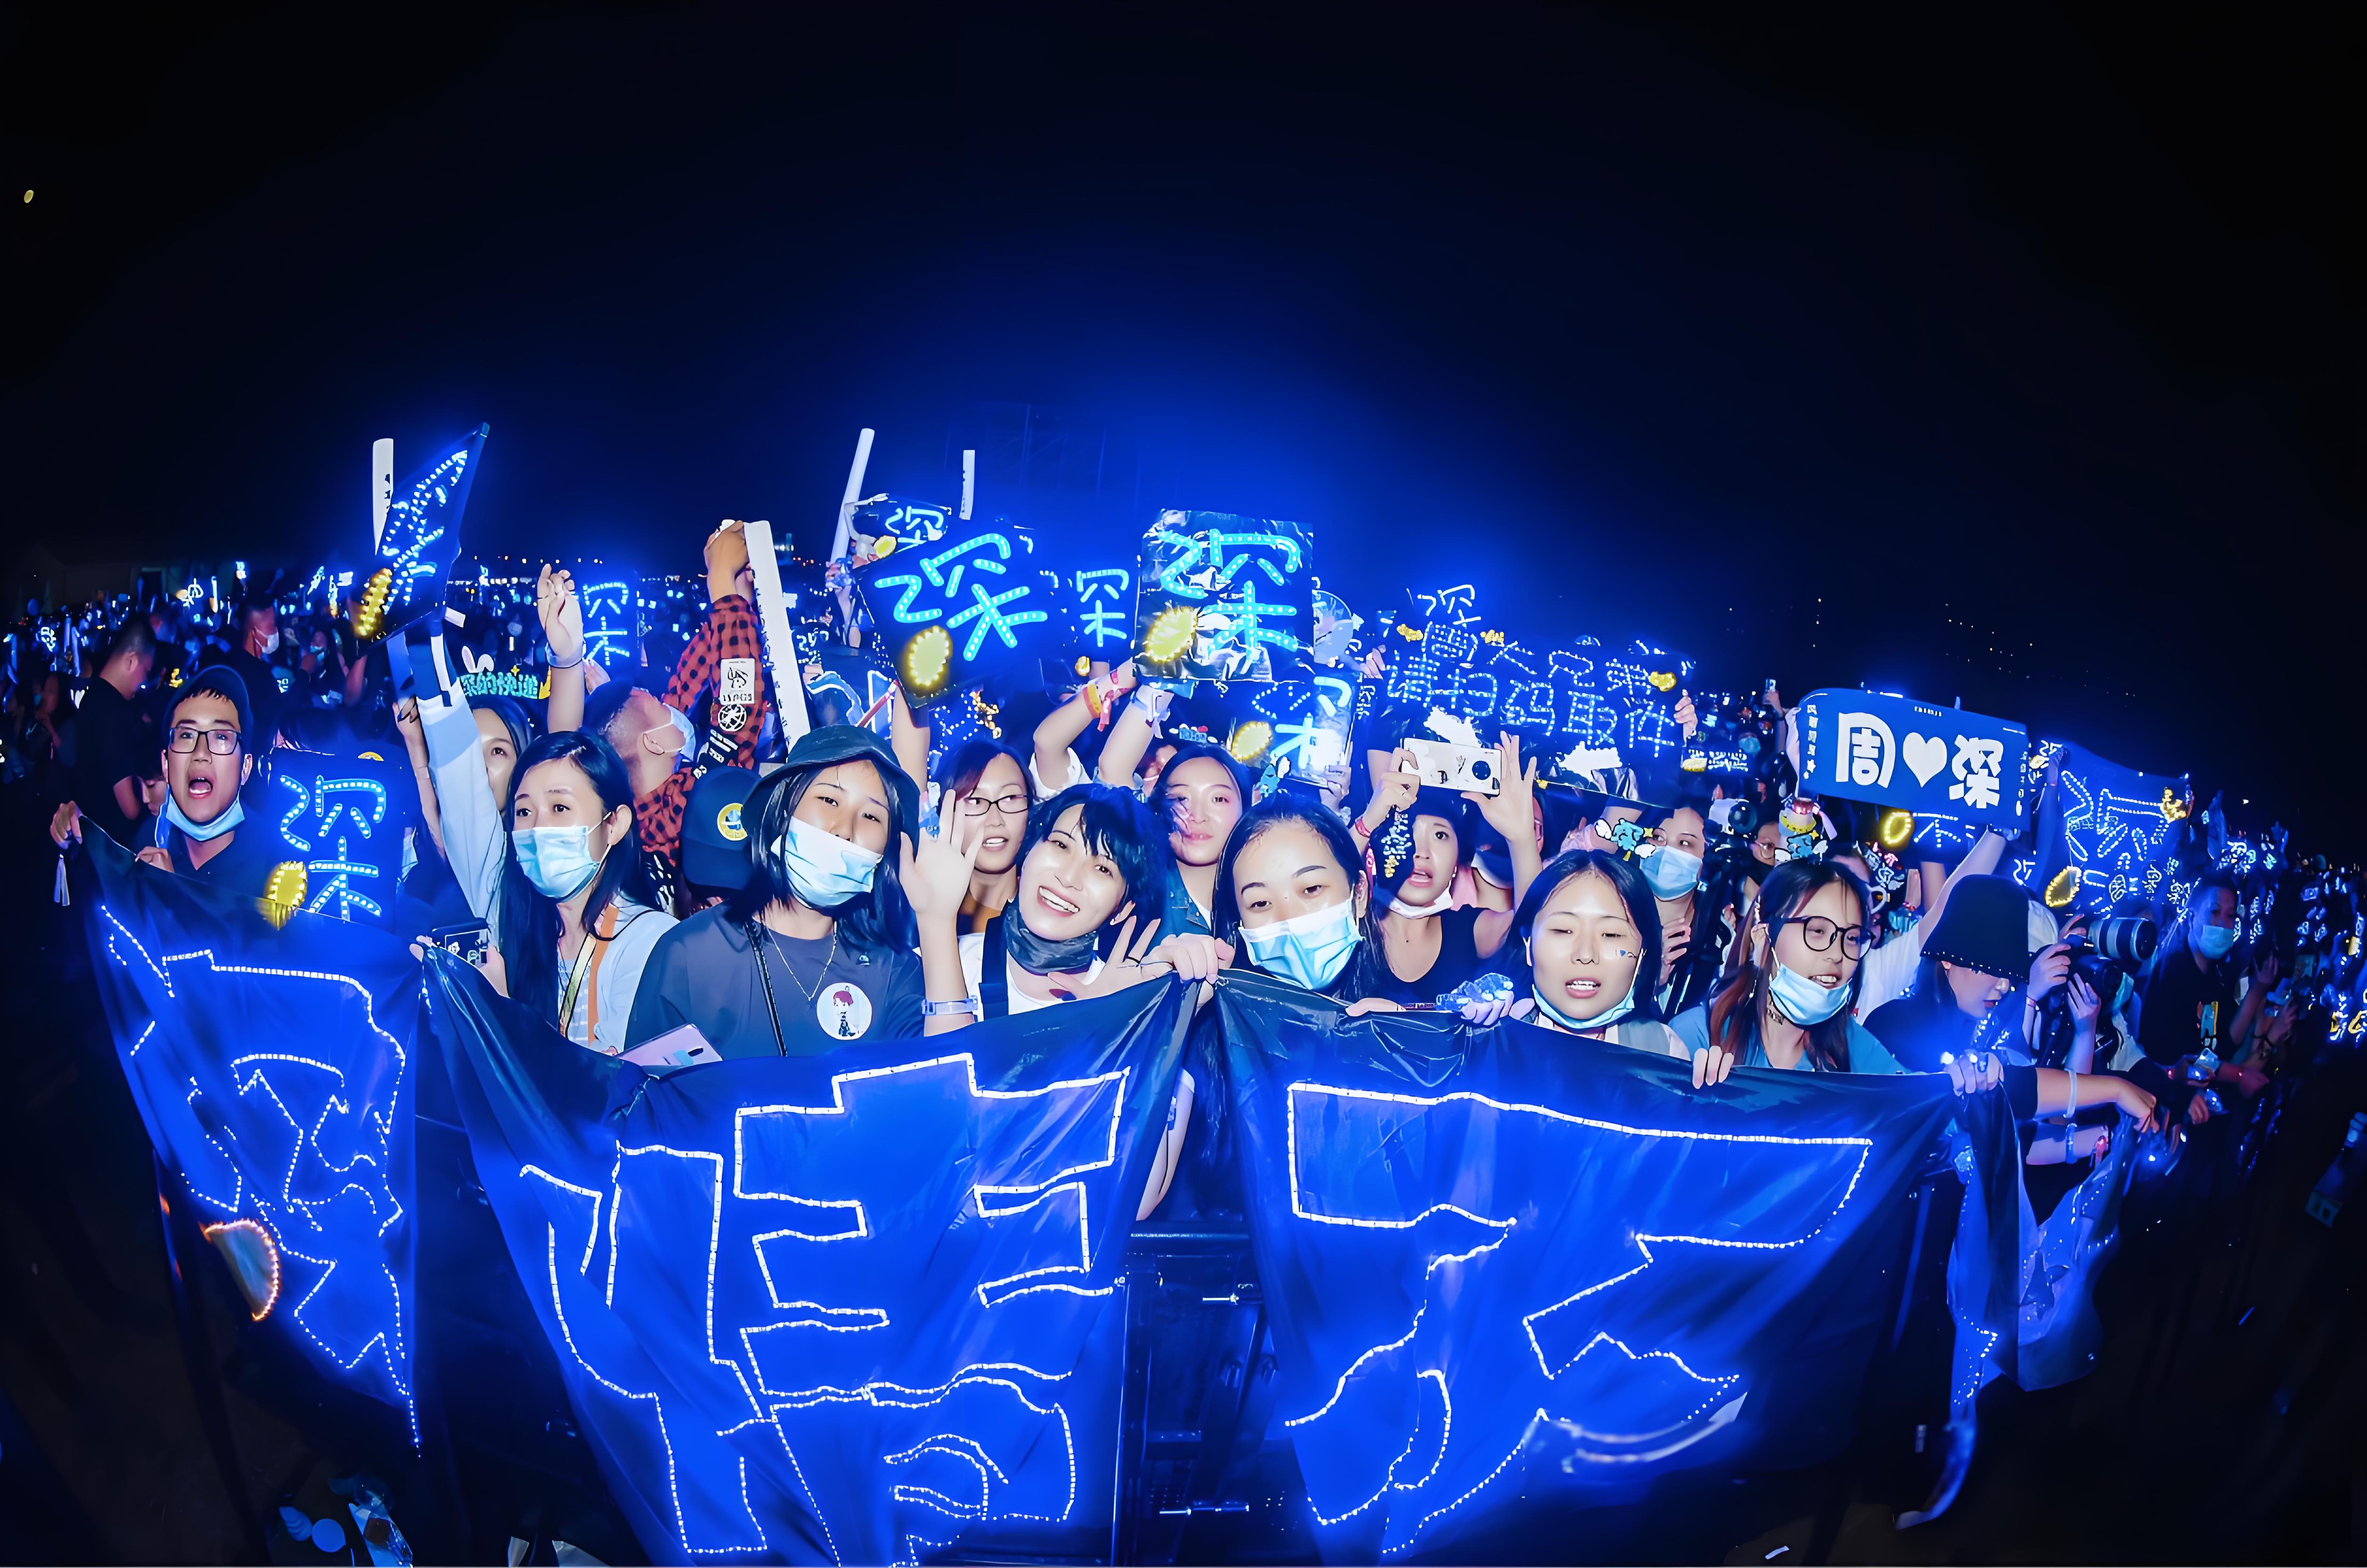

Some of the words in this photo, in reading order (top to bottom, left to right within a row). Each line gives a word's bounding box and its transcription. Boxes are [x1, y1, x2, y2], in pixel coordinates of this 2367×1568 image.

[875, 532, 1048, 661] 深
[1157, 528, 1300, 661] 深
[1836, 712, 1896, 788] 周
[1949, 736, 2004, 809] 深
[280, 775, 387, 921] 深
